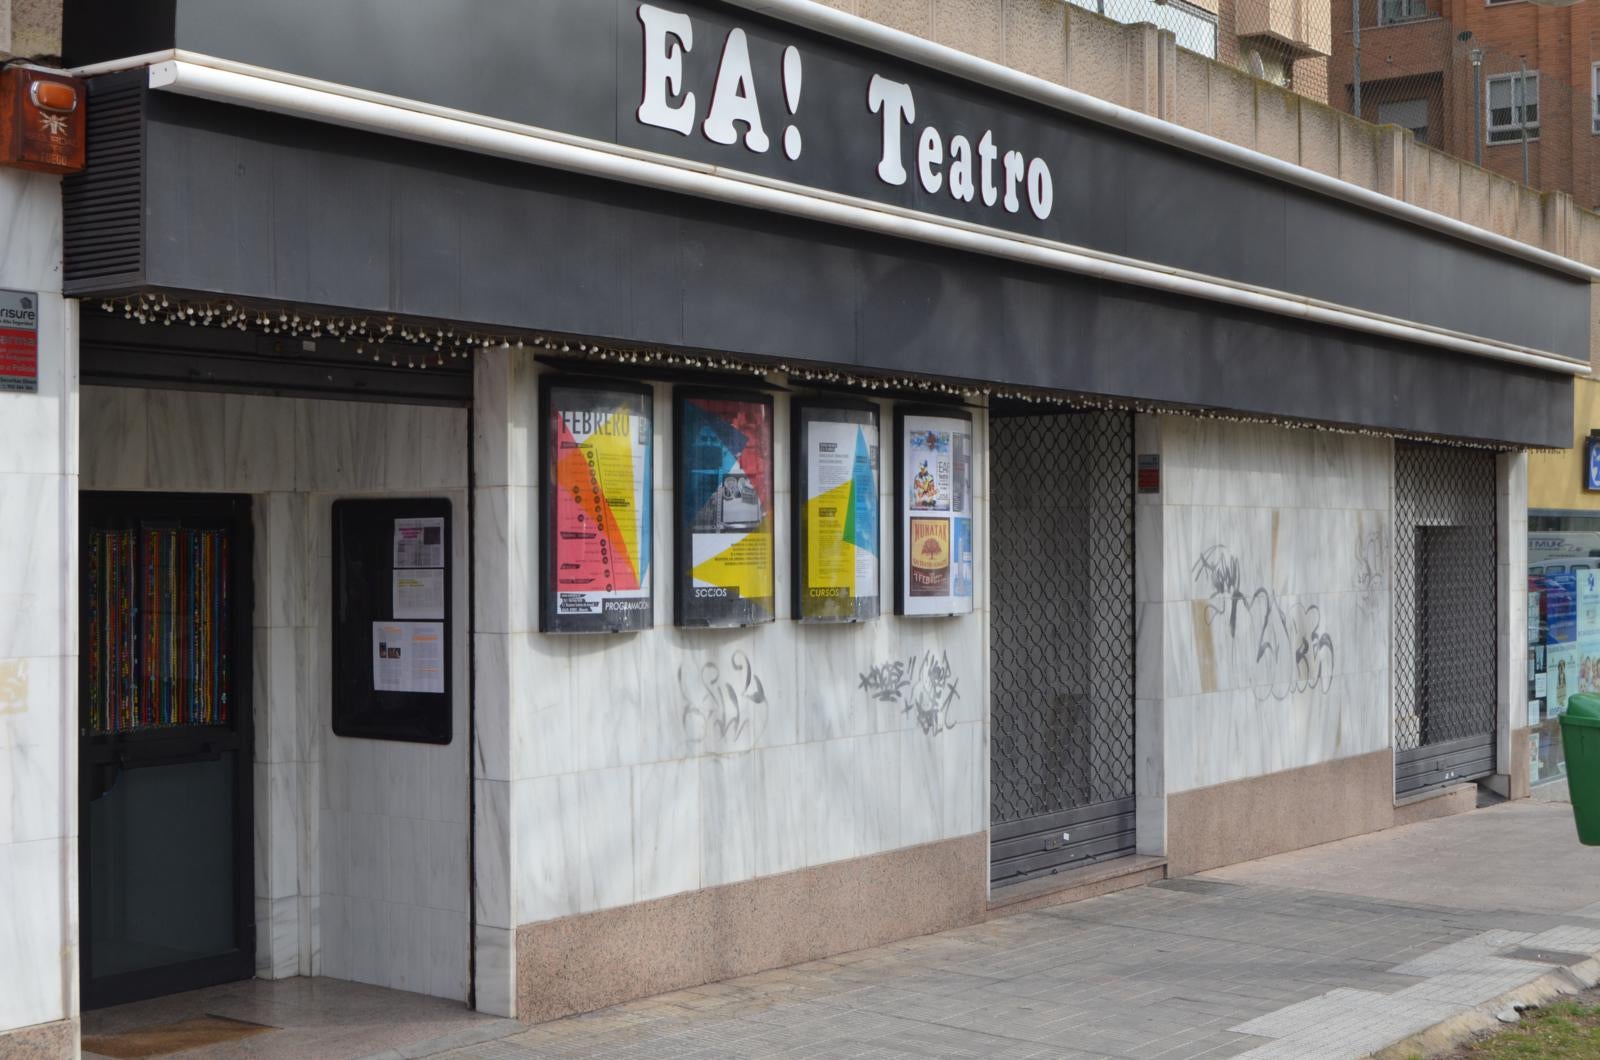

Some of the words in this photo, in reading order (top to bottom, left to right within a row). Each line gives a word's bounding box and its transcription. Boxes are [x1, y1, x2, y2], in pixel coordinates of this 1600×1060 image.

[637, 4, 801, 160] EA!
[867, 73, 1054, 220] Teatro
[561, 410, 630, 436] FEBRERO
[914, 522, 947, 541] NUNATAK
[695, 588, 727, 598] SOCIOS
[809, 588, 840, 597] CURSOS
